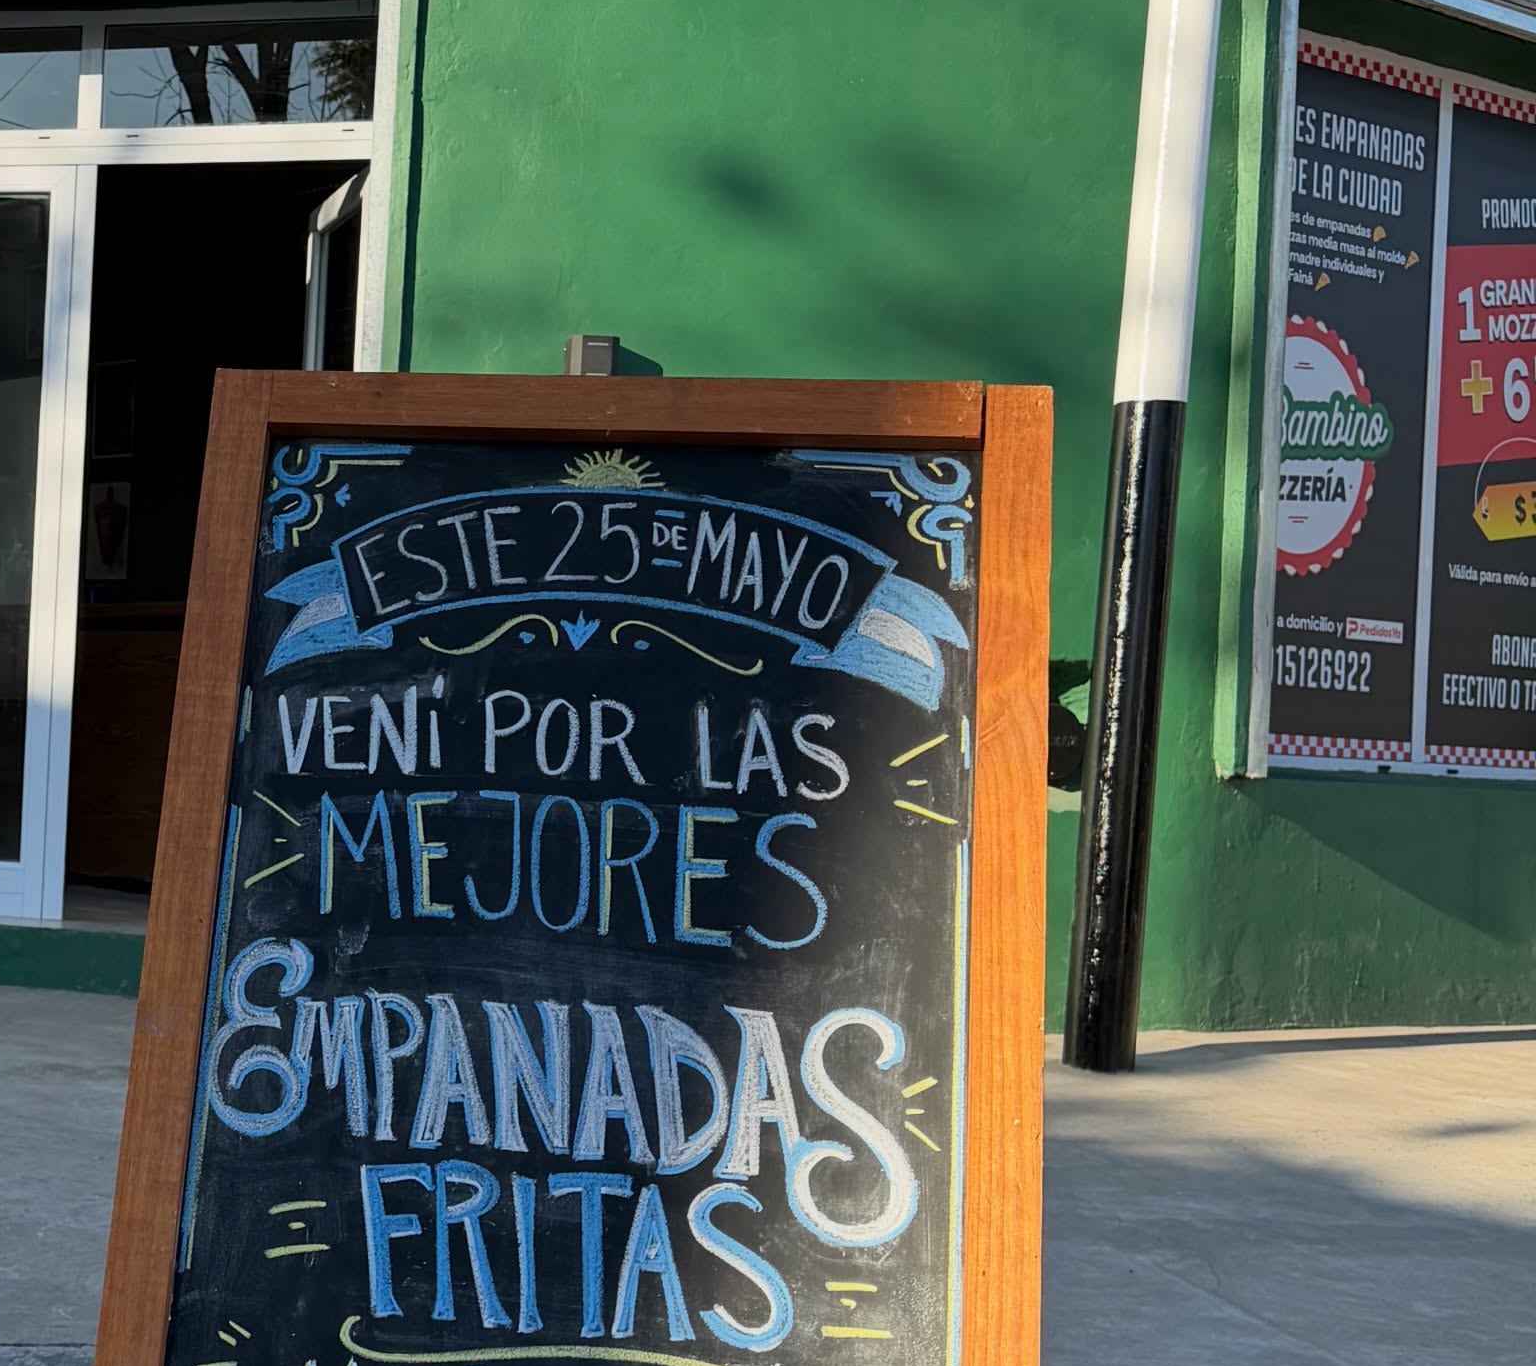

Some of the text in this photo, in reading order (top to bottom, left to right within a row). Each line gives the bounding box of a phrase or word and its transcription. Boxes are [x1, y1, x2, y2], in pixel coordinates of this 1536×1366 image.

[1321, 110, 1426, 172] EMPANADAS
[1313, 161, 1334, 201] LA
[1338, 167, 1403, 217] CIUDAD
[1289, 231, 1407, 266] zas media masa al molde
[1302, 212, 1315, 226] de
[1317, 217, 1372, 239] empanadas
[1289, 251, 1385, 284] madre individuales y
[1457, 278, 1536, 342] 1 GRAN
[355, 500, 850, 631] ESTE 25 DE MAYO
[1448, 562, 1478, 582] Válida
[1479, 570, 1503, 586] para
[1503, 571, 1529, 587] envío
[1285, 612, 1336, 634] domicilio
[1336, 621, 1344, 638] y
[1271, 643, 1372, 693] 15126922
[1441, 672, 1507, 709] EFECTIVO
[1510, 676, 1523, 710] O
[484, 688, 650, 786] POR
[695, 697, 851, 801] LAS
[320, 790, 829, 950] MEJORES
[209, 938, 921, 1248] EMPANADAS
[360, 1159, 795, 1354] FRITAS
